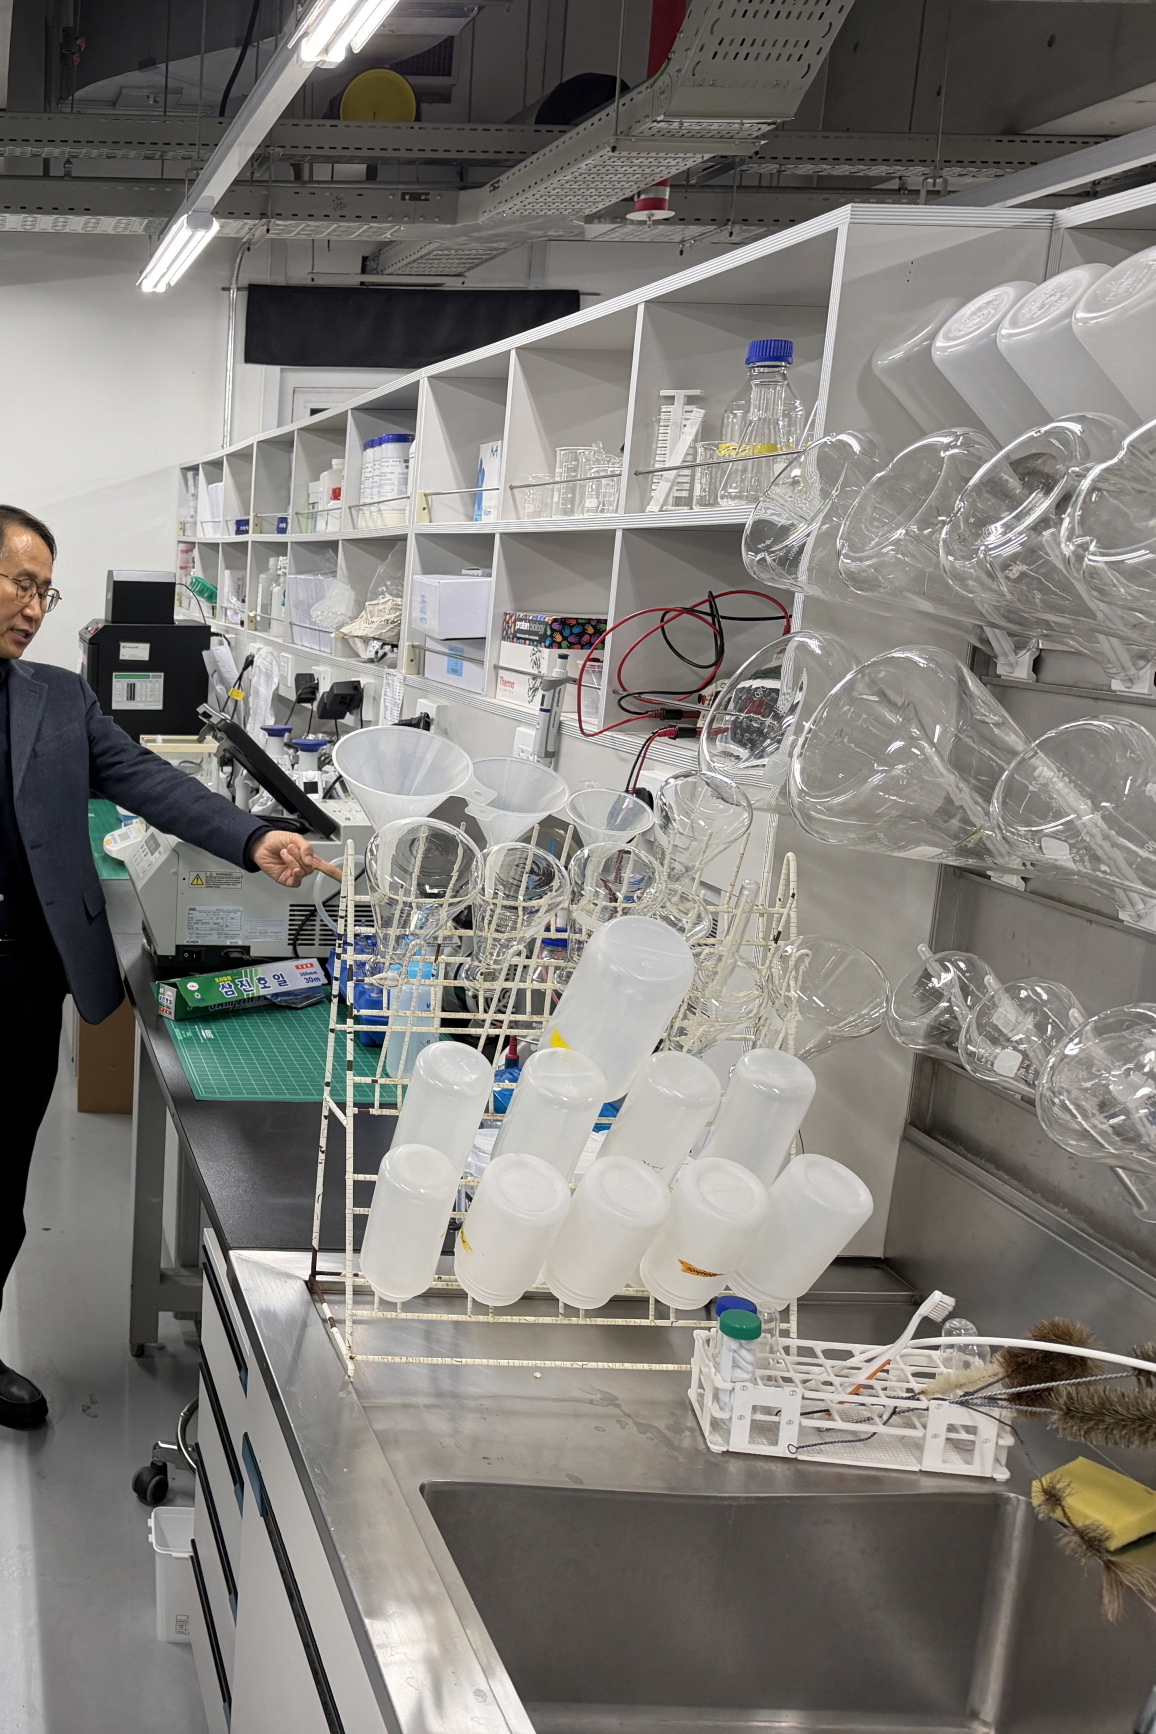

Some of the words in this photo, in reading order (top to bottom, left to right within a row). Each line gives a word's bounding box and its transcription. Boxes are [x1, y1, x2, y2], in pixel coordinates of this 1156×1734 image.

[515, 620, 530, 631] protein
[499, 676, 515, 689] Thermo
[219, 973, 290, 998] 삼진호일
[304, 976, 321, 985] 30m
